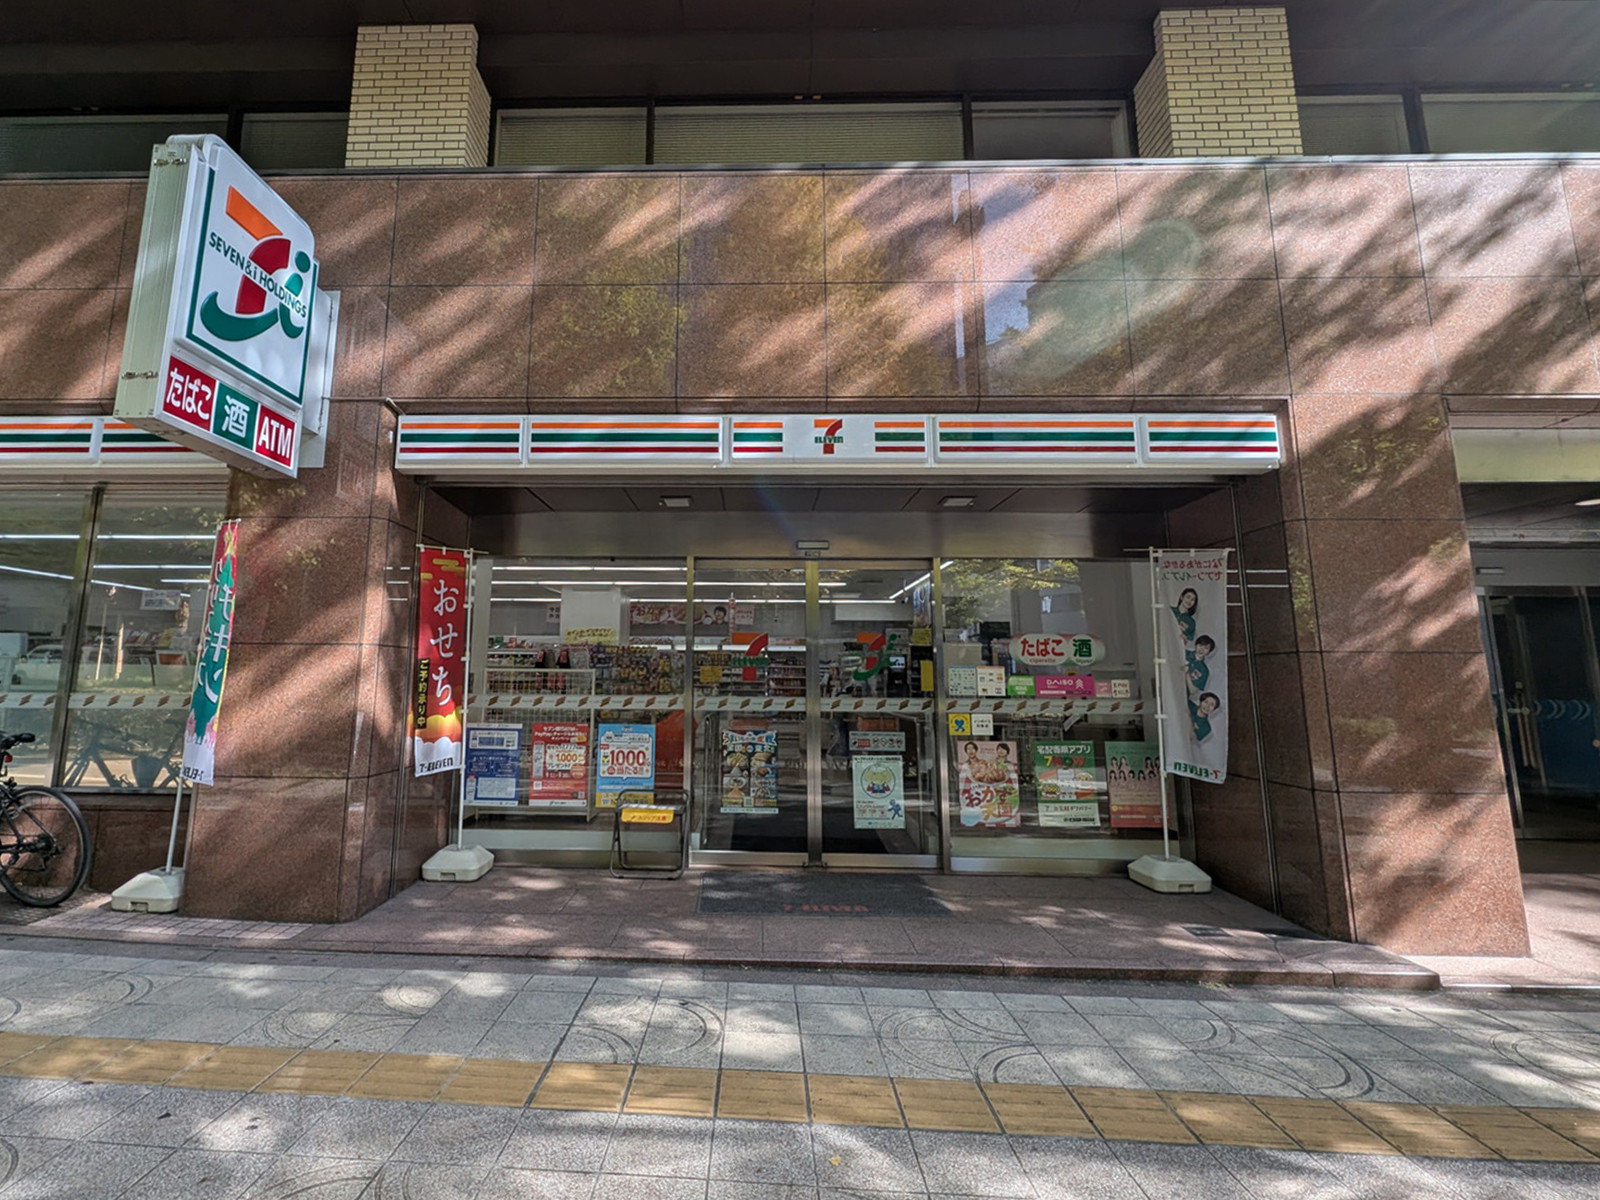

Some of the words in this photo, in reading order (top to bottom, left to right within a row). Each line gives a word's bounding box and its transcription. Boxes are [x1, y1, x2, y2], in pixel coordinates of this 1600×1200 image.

[259, 272, 308, 318] HOLDINGS
[165, 367, 212, 420] たばこ
[221, 394, 250, 439] 酒
[257, 415, 293, 459] ATM
[430, 578, 459, 707] おせち
[1020, 638, 1065, 657] たばこ
[1072, 638, 1093, 657] 酒
[1046, 678, 1073, 686] DAISO
